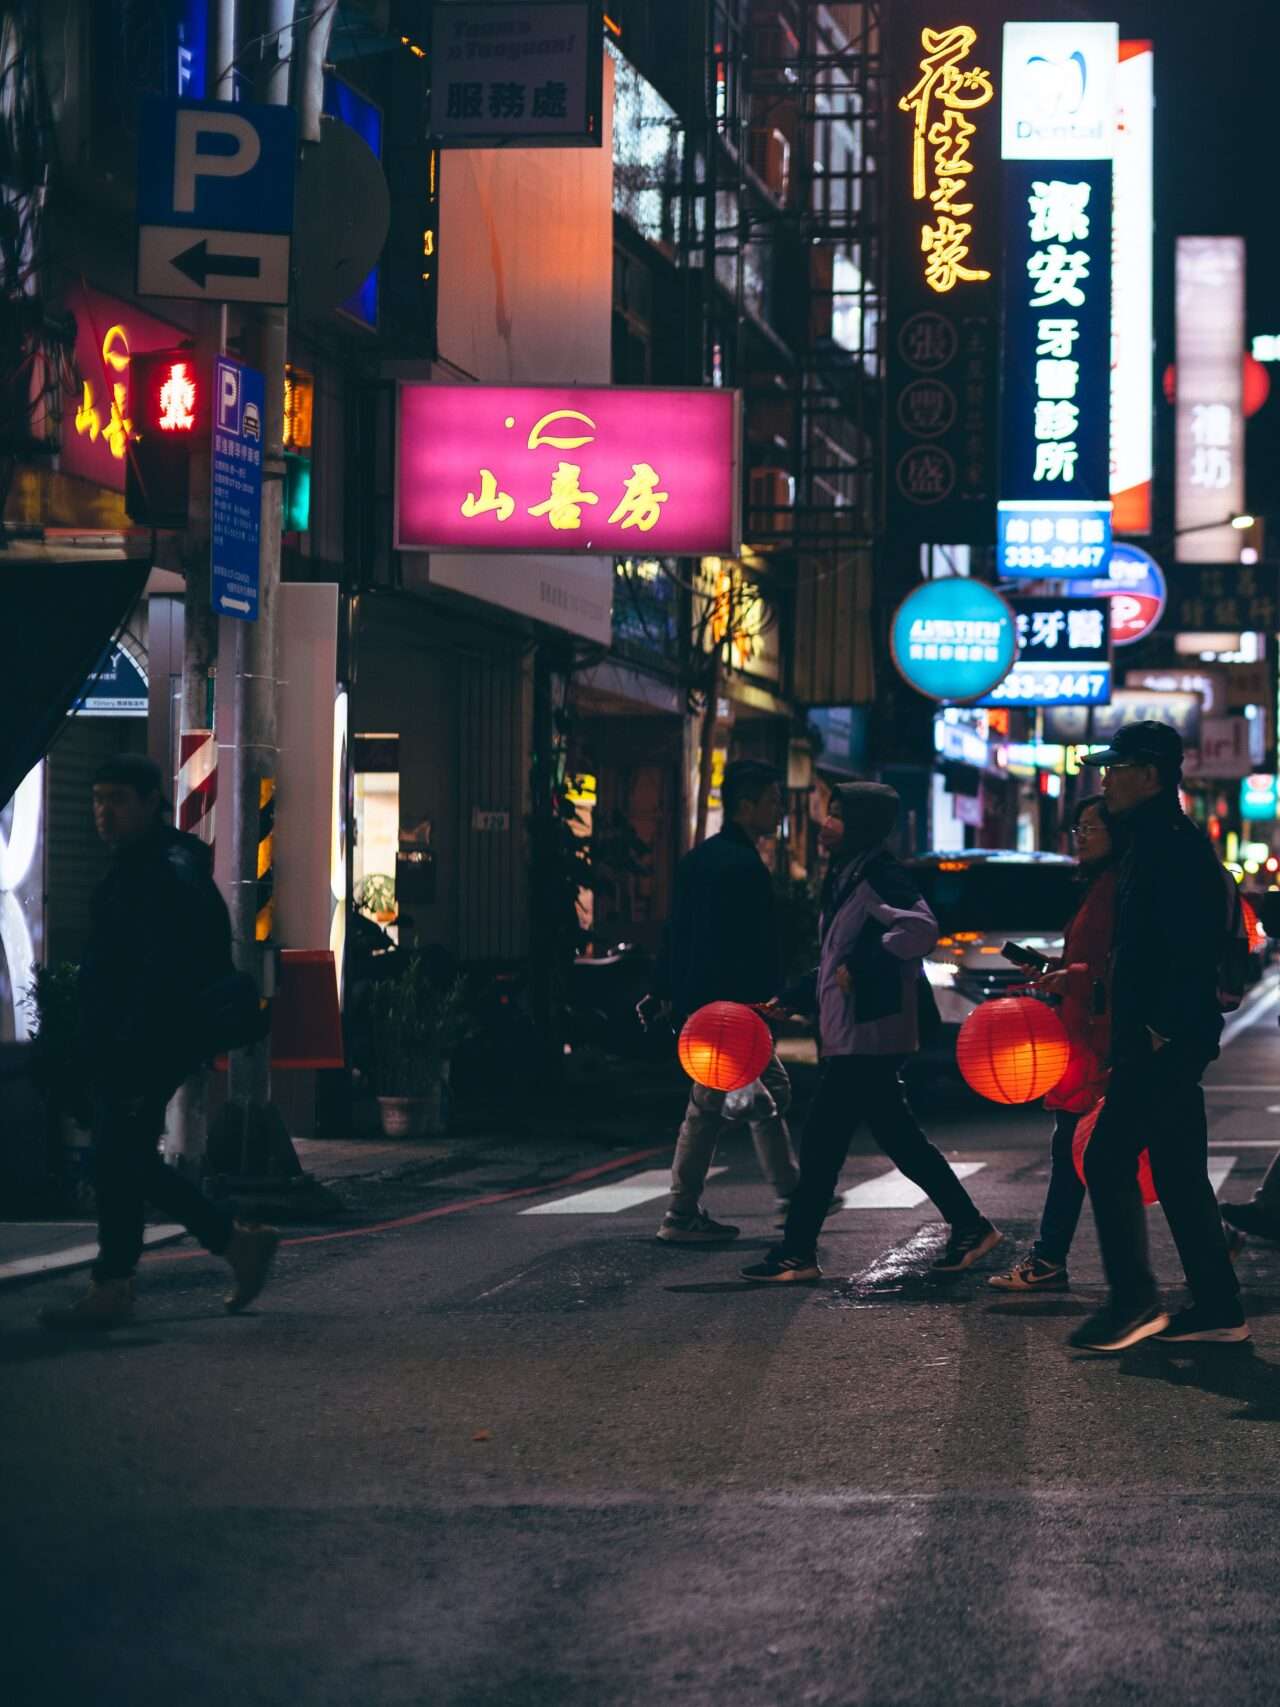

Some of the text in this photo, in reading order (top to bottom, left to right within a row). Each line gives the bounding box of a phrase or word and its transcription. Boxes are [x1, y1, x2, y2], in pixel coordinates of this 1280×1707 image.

[446, 80, 568, 119] 服務處
[1016, 120, 1103, 139] Dental
[173, 109, 261, 213] P
